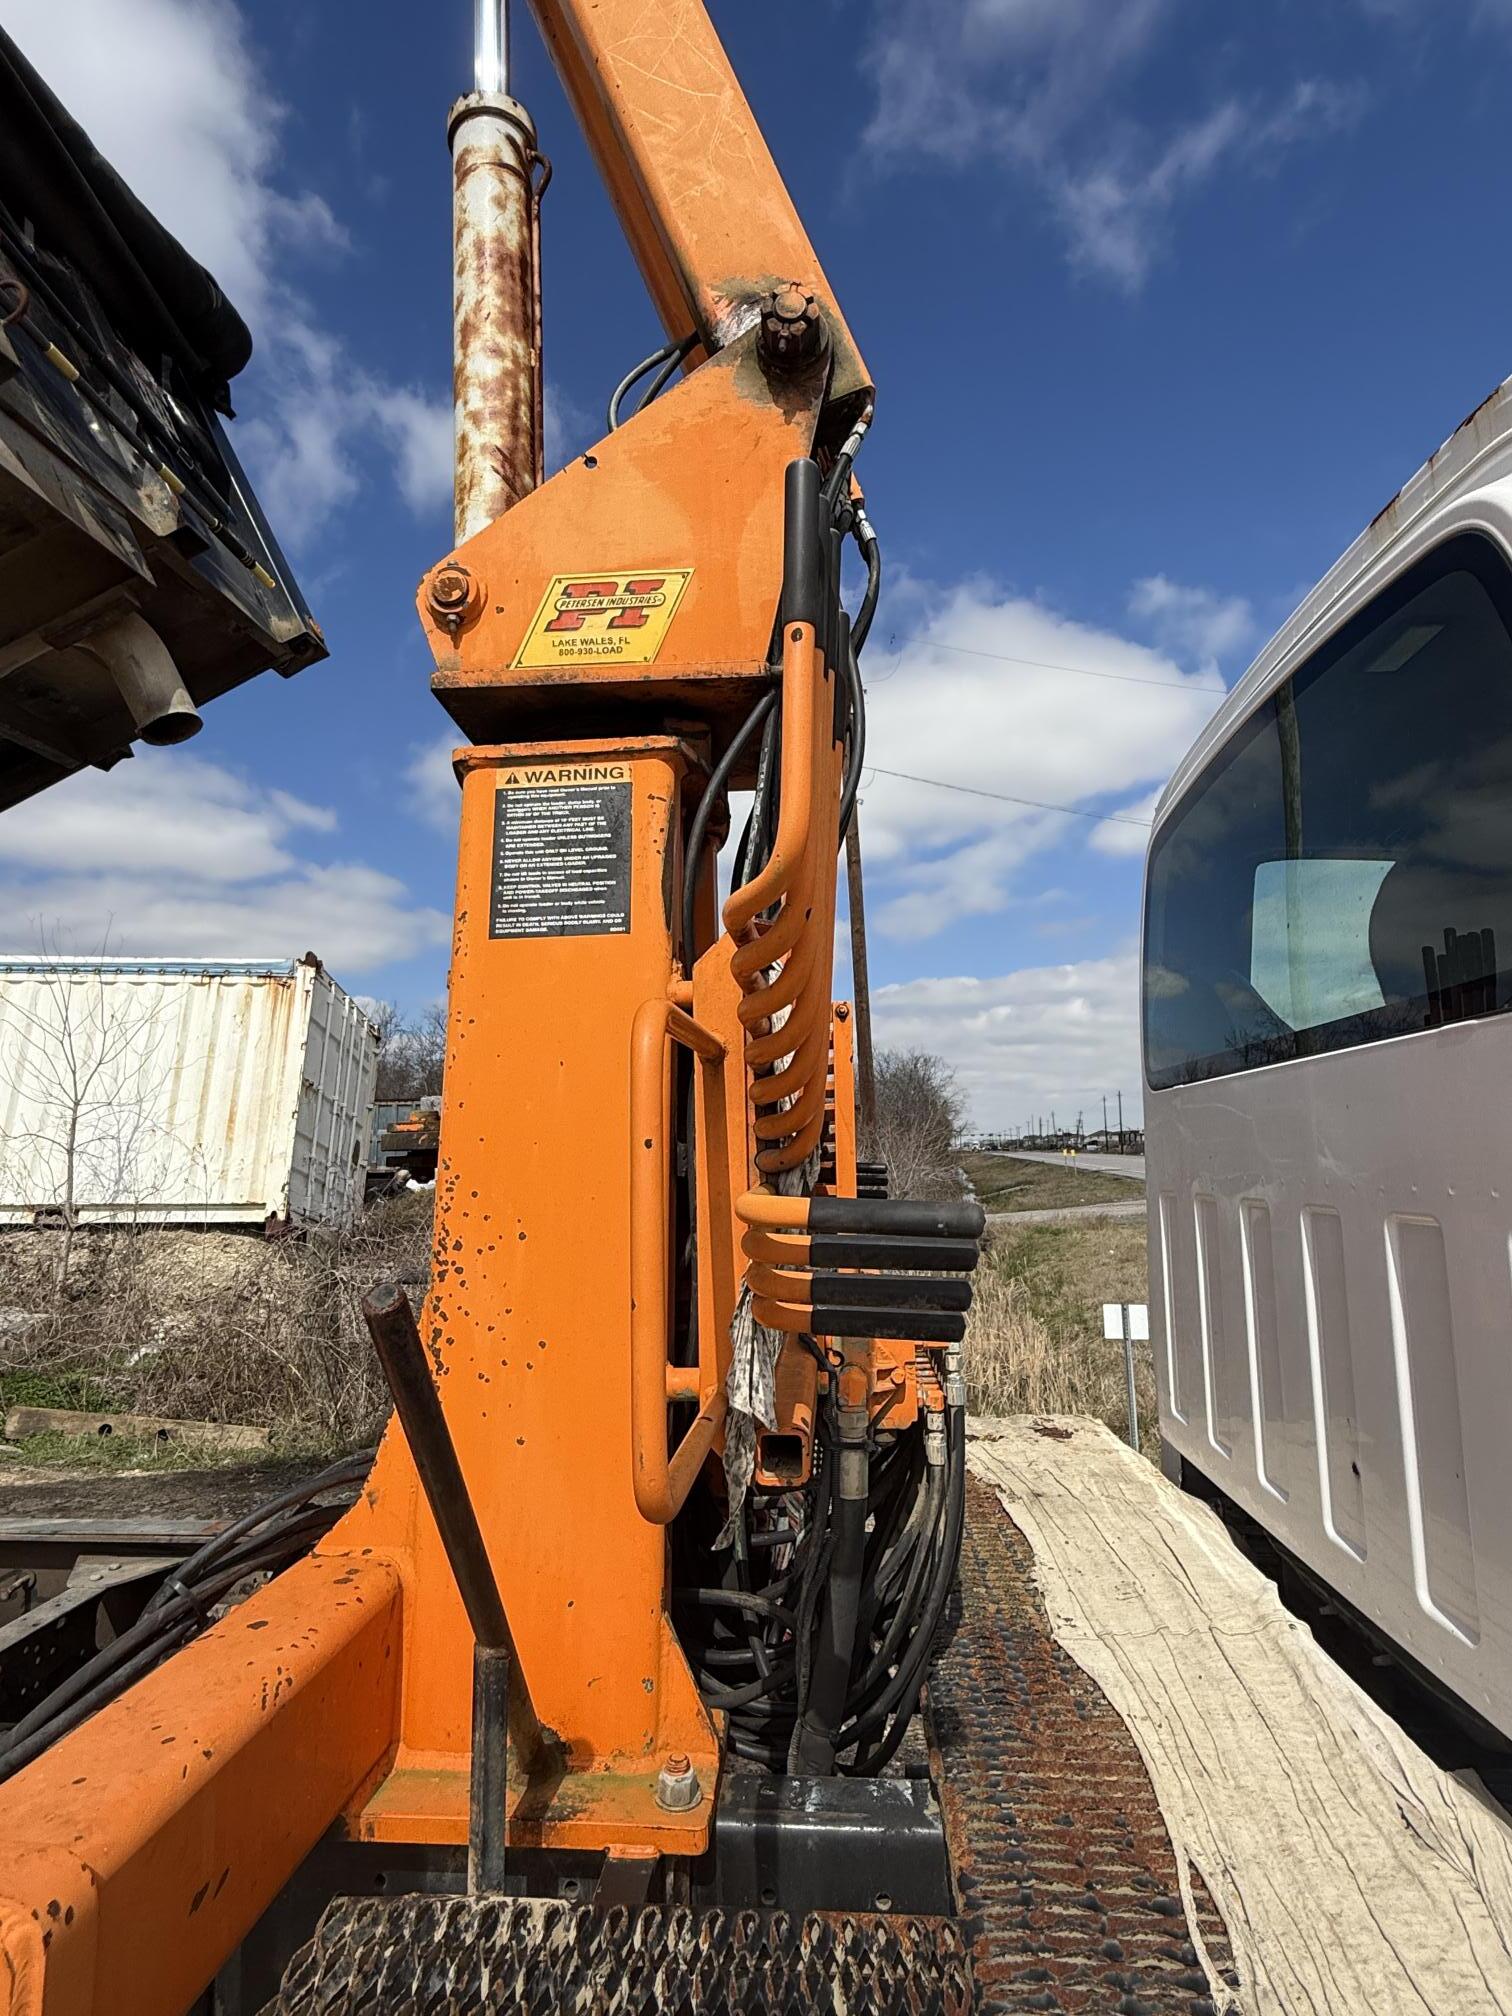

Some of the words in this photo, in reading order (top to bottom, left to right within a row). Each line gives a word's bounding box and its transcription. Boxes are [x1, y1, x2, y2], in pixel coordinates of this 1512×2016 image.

[559, 598, 604, 609] PETERSEN
[606, 595, 658, 606] INDUSTRIES
[552, 639, 577, 648] LAKE
[580, 637, 616, 647] WALES,
[619, 637, 630, 645] FL
[559, 646, 623, 656] 800-930-LOAD
[525, 766, 624, 783] WARNING
